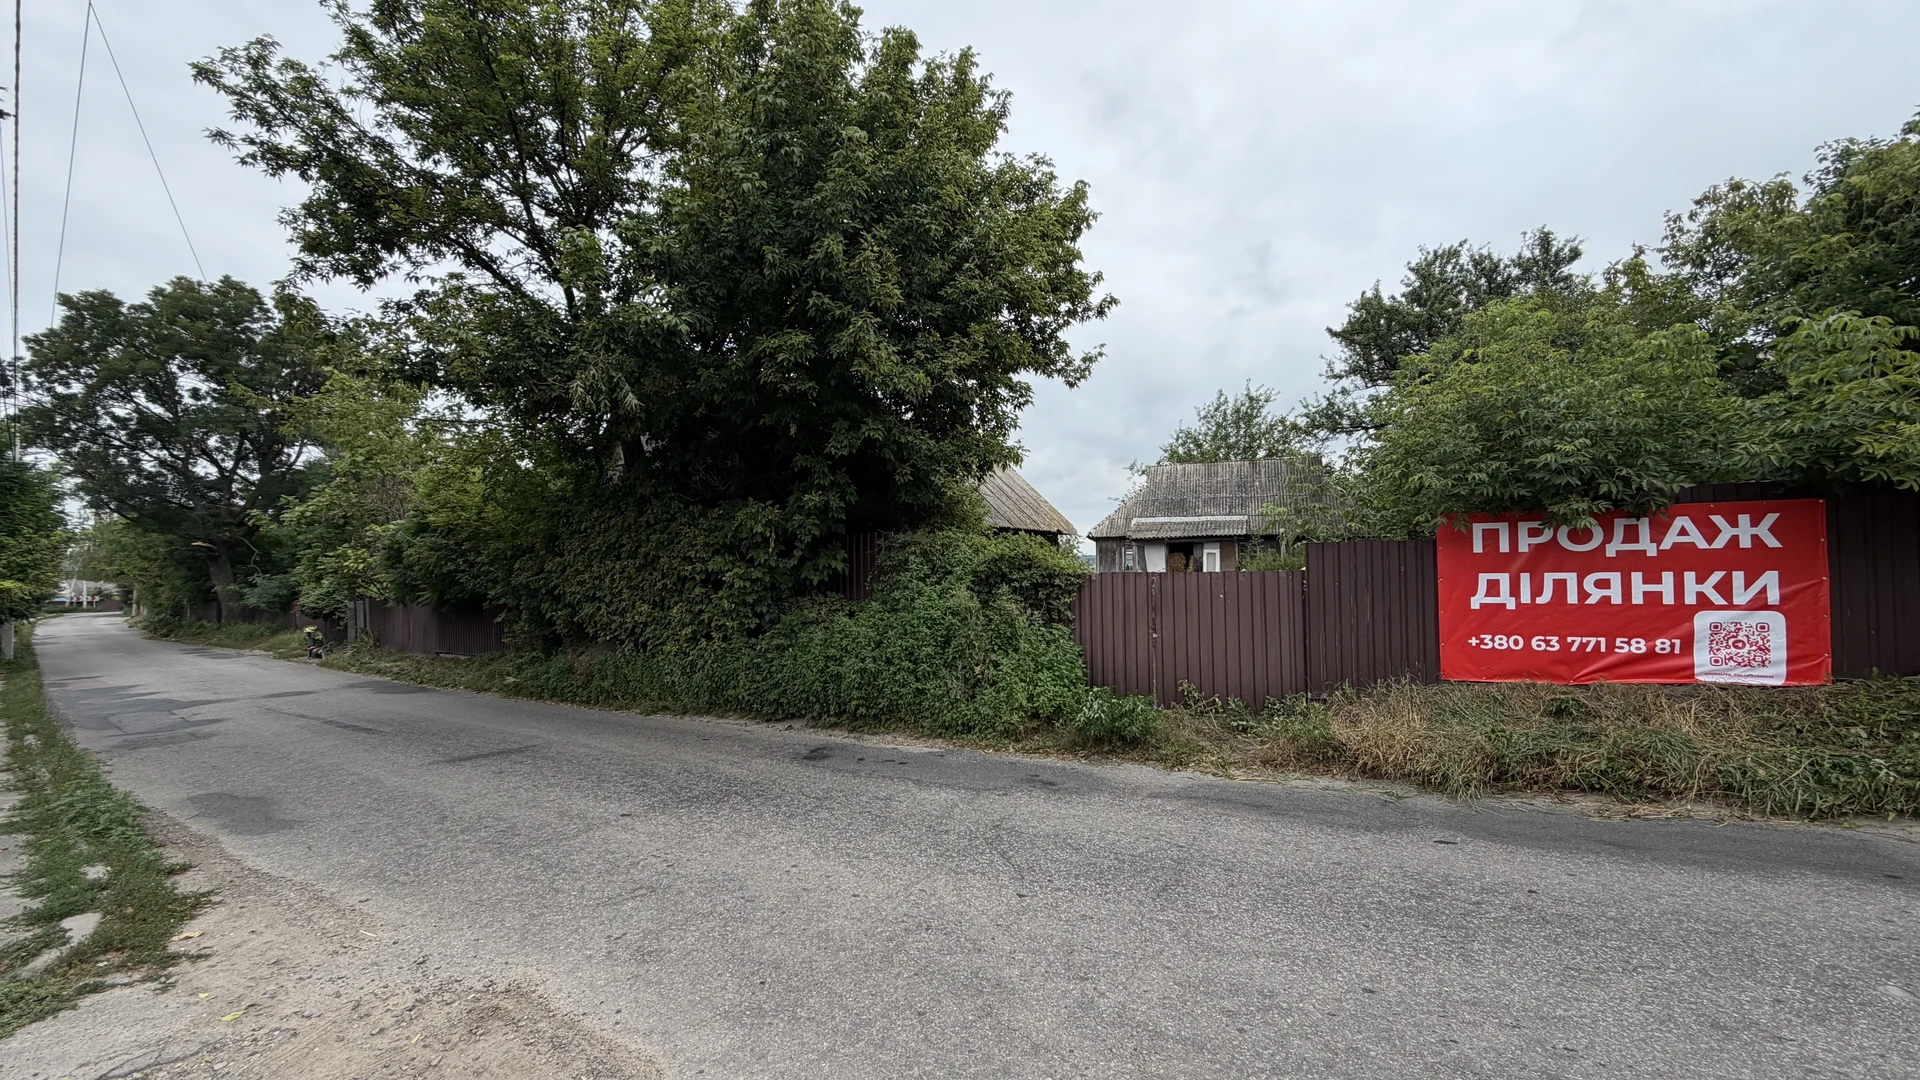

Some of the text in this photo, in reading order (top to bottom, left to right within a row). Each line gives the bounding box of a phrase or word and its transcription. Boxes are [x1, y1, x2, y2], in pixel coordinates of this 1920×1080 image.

[1472, 513, 1783, 557] ПРОДАЖ
[1470, 571, 1781, 610] ДІЛЯНКИ
[1467, 634, 1681, 655] +380 63 771 58 81
